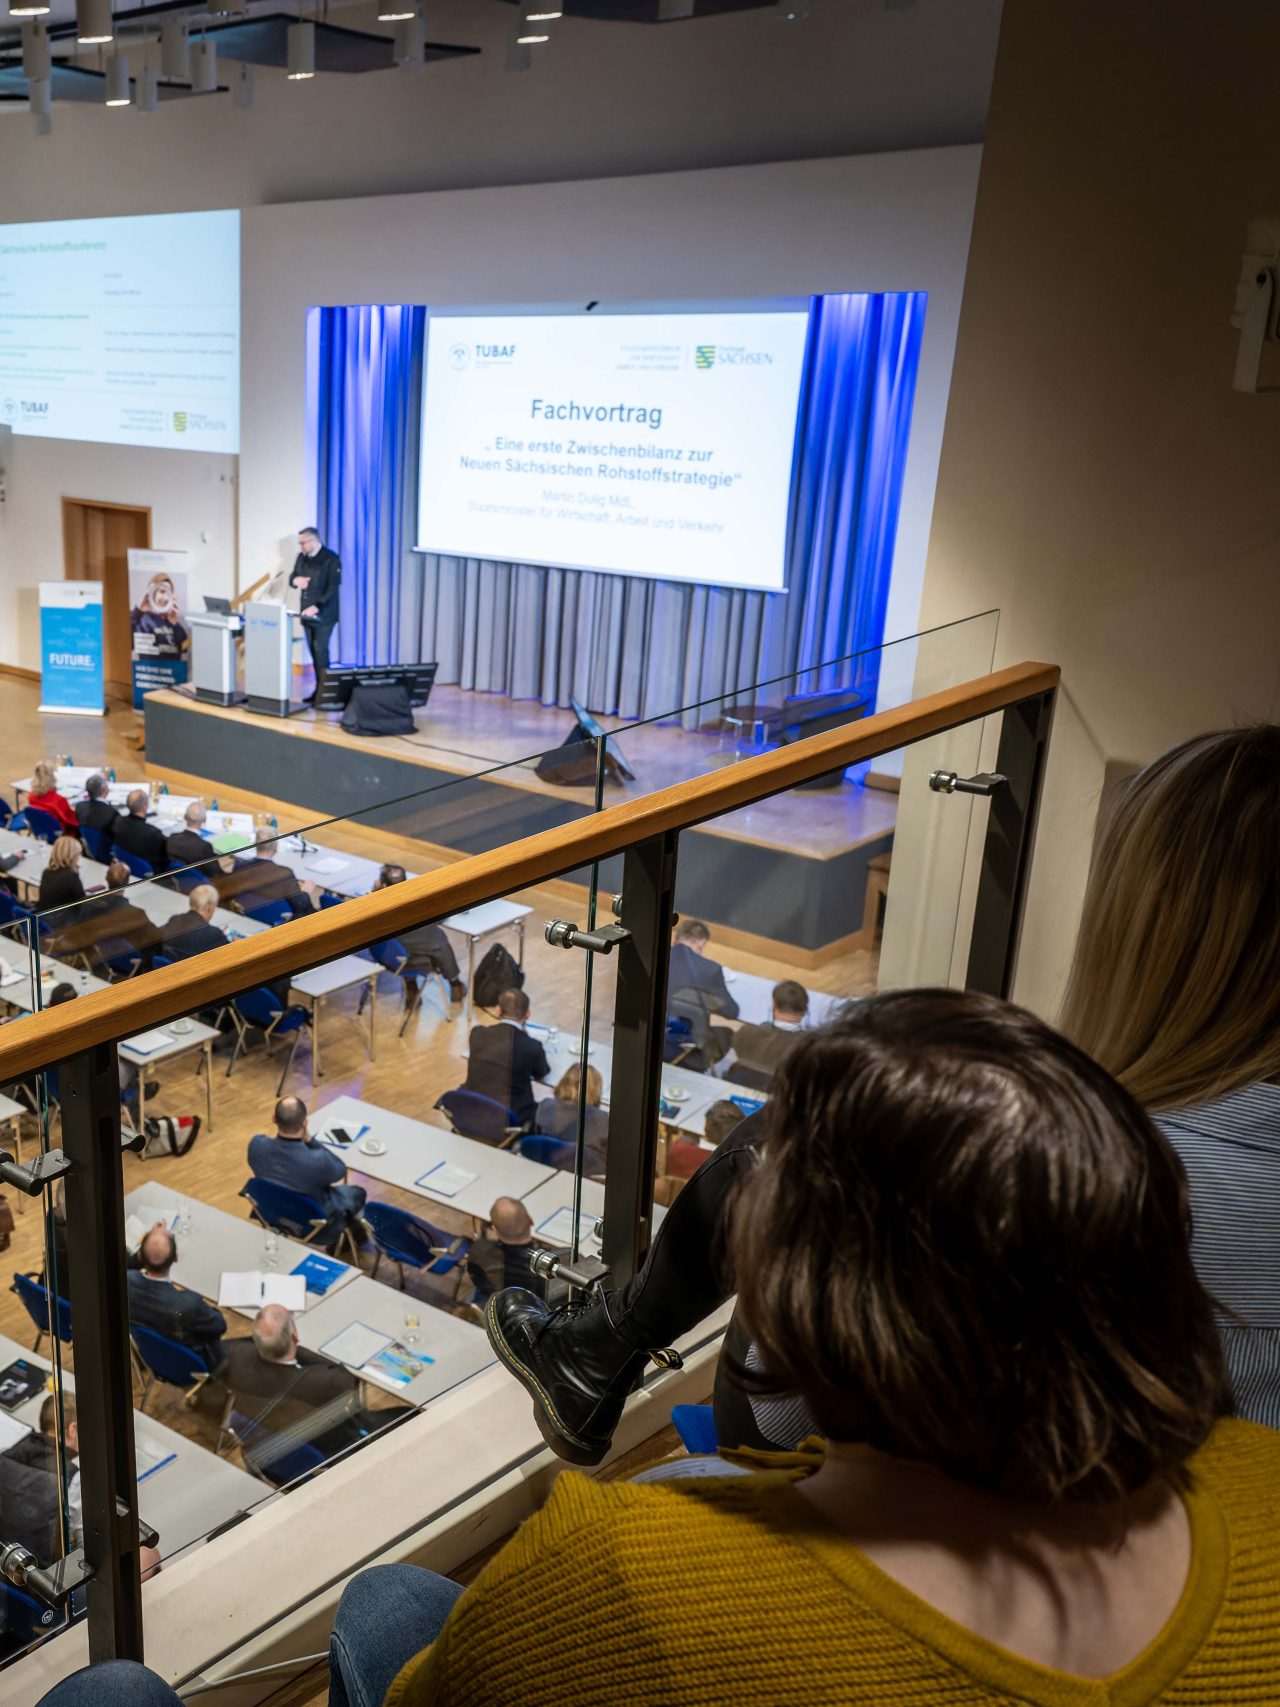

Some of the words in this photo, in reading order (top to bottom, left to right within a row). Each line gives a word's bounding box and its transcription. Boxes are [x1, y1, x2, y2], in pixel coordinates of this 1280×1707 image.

[476, 344, 516, 358] TUBAF
[530, 399, 663, 430] Fachvortrag
[495, 436, 524, 452] Eine
[528, 440, 562, 454] erste
[566, 440, 683, 461] Zwischenbilanz
[687, 450, 713, 463] zur
[460, 456, 501, 471] Neuen
[505, 457, 593, 477] Sächsischen
[49, 652, 95, 667] FUTURE.
